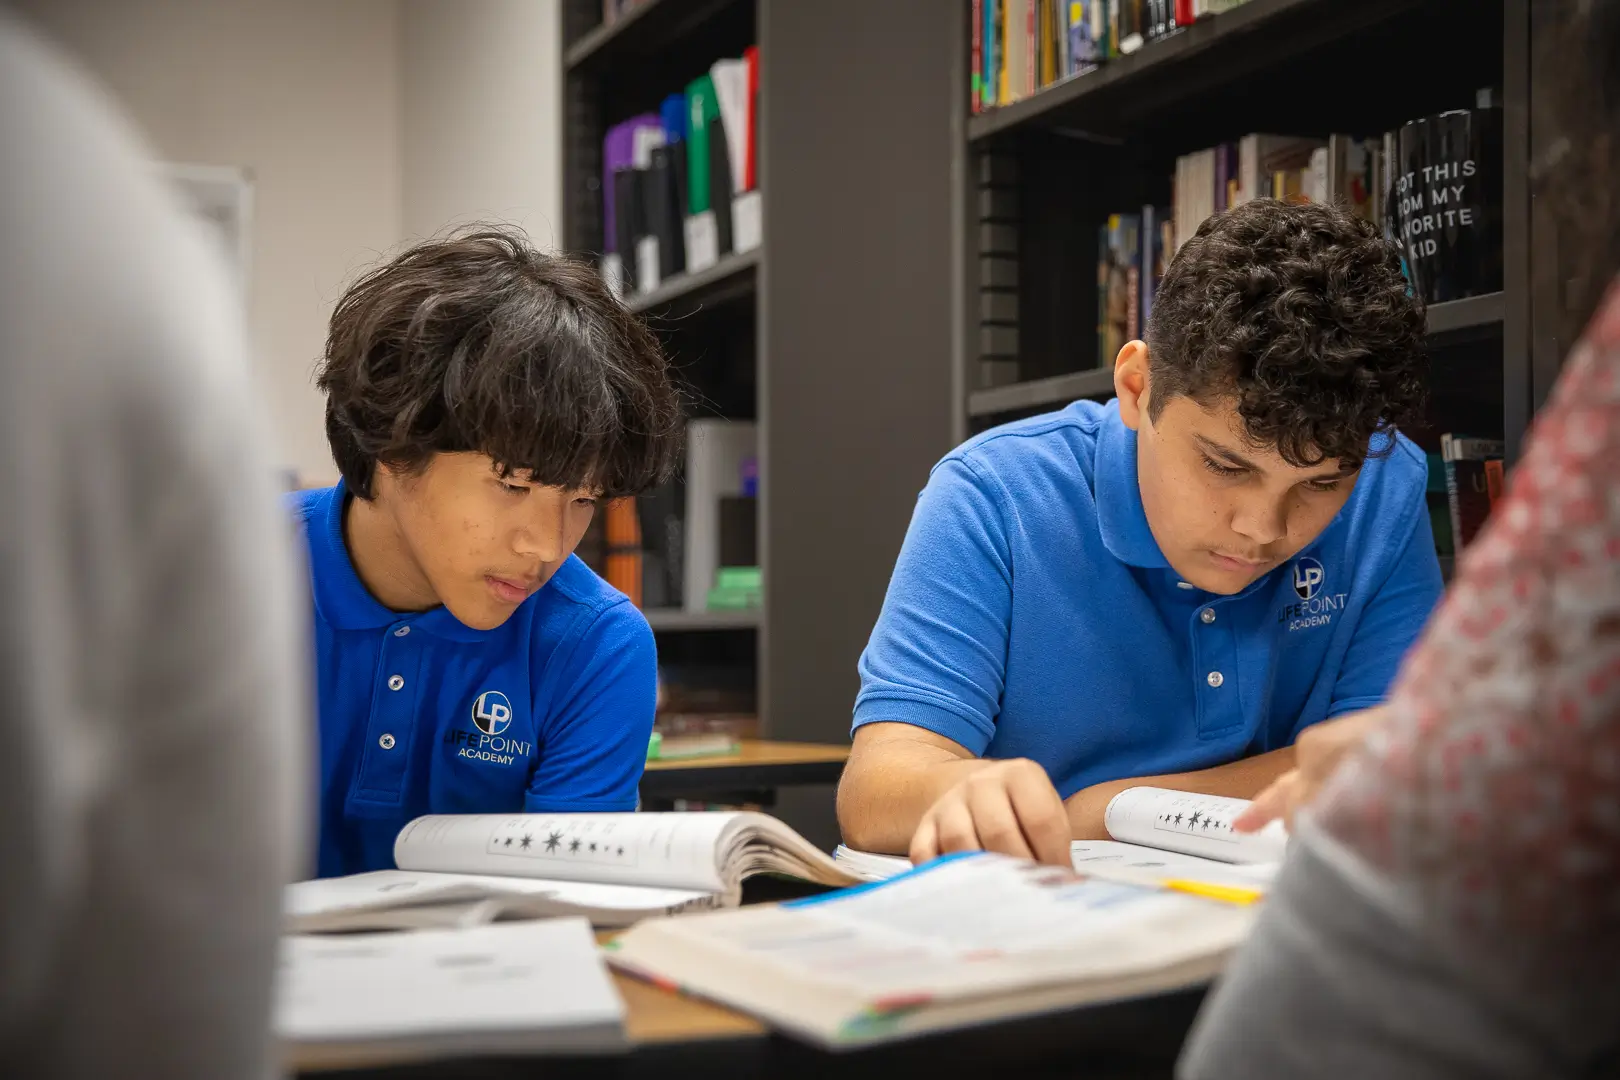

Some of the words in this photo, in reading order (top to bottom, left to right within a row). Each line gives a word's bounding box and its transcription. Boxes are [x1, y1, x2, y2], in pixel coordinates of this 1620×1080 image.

[1422, 160, 1476, 184] THIS
[1432, 184, 1465, 206] MY
[1410, 238, 1437, 260] KID
[1294, 562, 1323, 600] LP
[1278, 594, 1347, 623] LIFEPOINT
[1289, 614, 1331, 632] ACADEMY
[475, 692, 511, 735] LP
[444, 729, 532, 756] LIFEPOINT
[458, 748, 514, 765] ACADEMY
